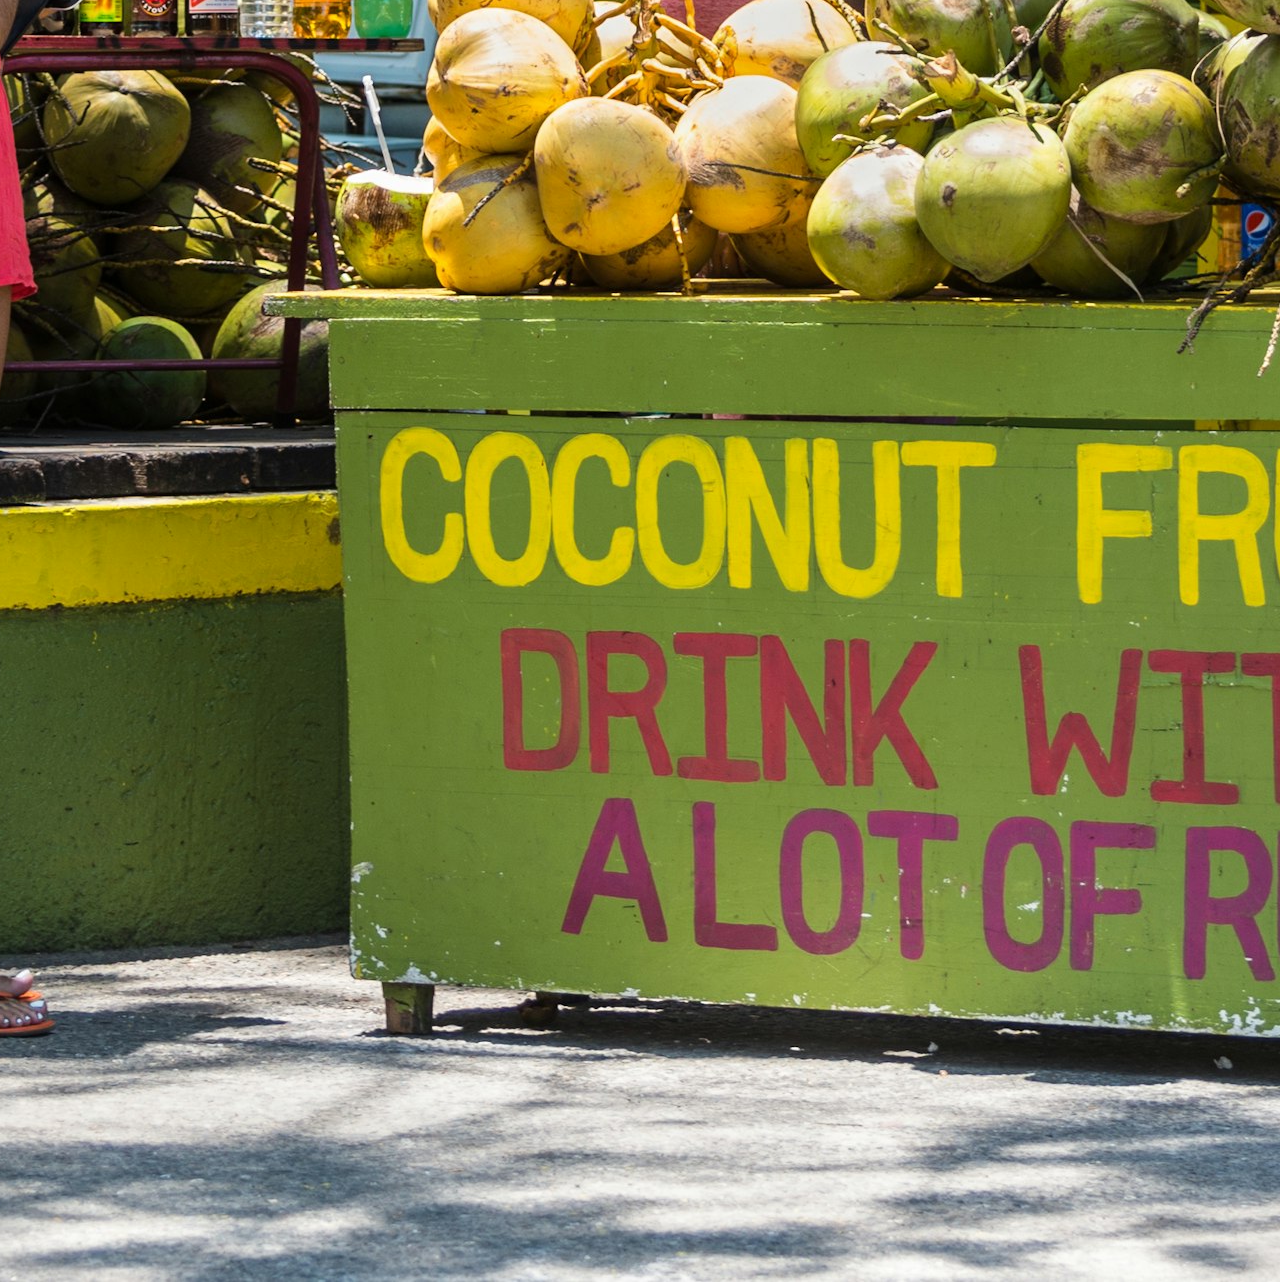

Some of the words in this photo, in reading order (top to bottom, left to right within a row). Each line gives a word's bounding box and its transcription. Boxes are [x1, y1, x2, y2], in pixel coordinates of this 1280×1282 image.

[142, 2, 168, 15] STOUT
[379, 425, 997, 598] COCONUT
[499, 627, 939, 791] DRINK
